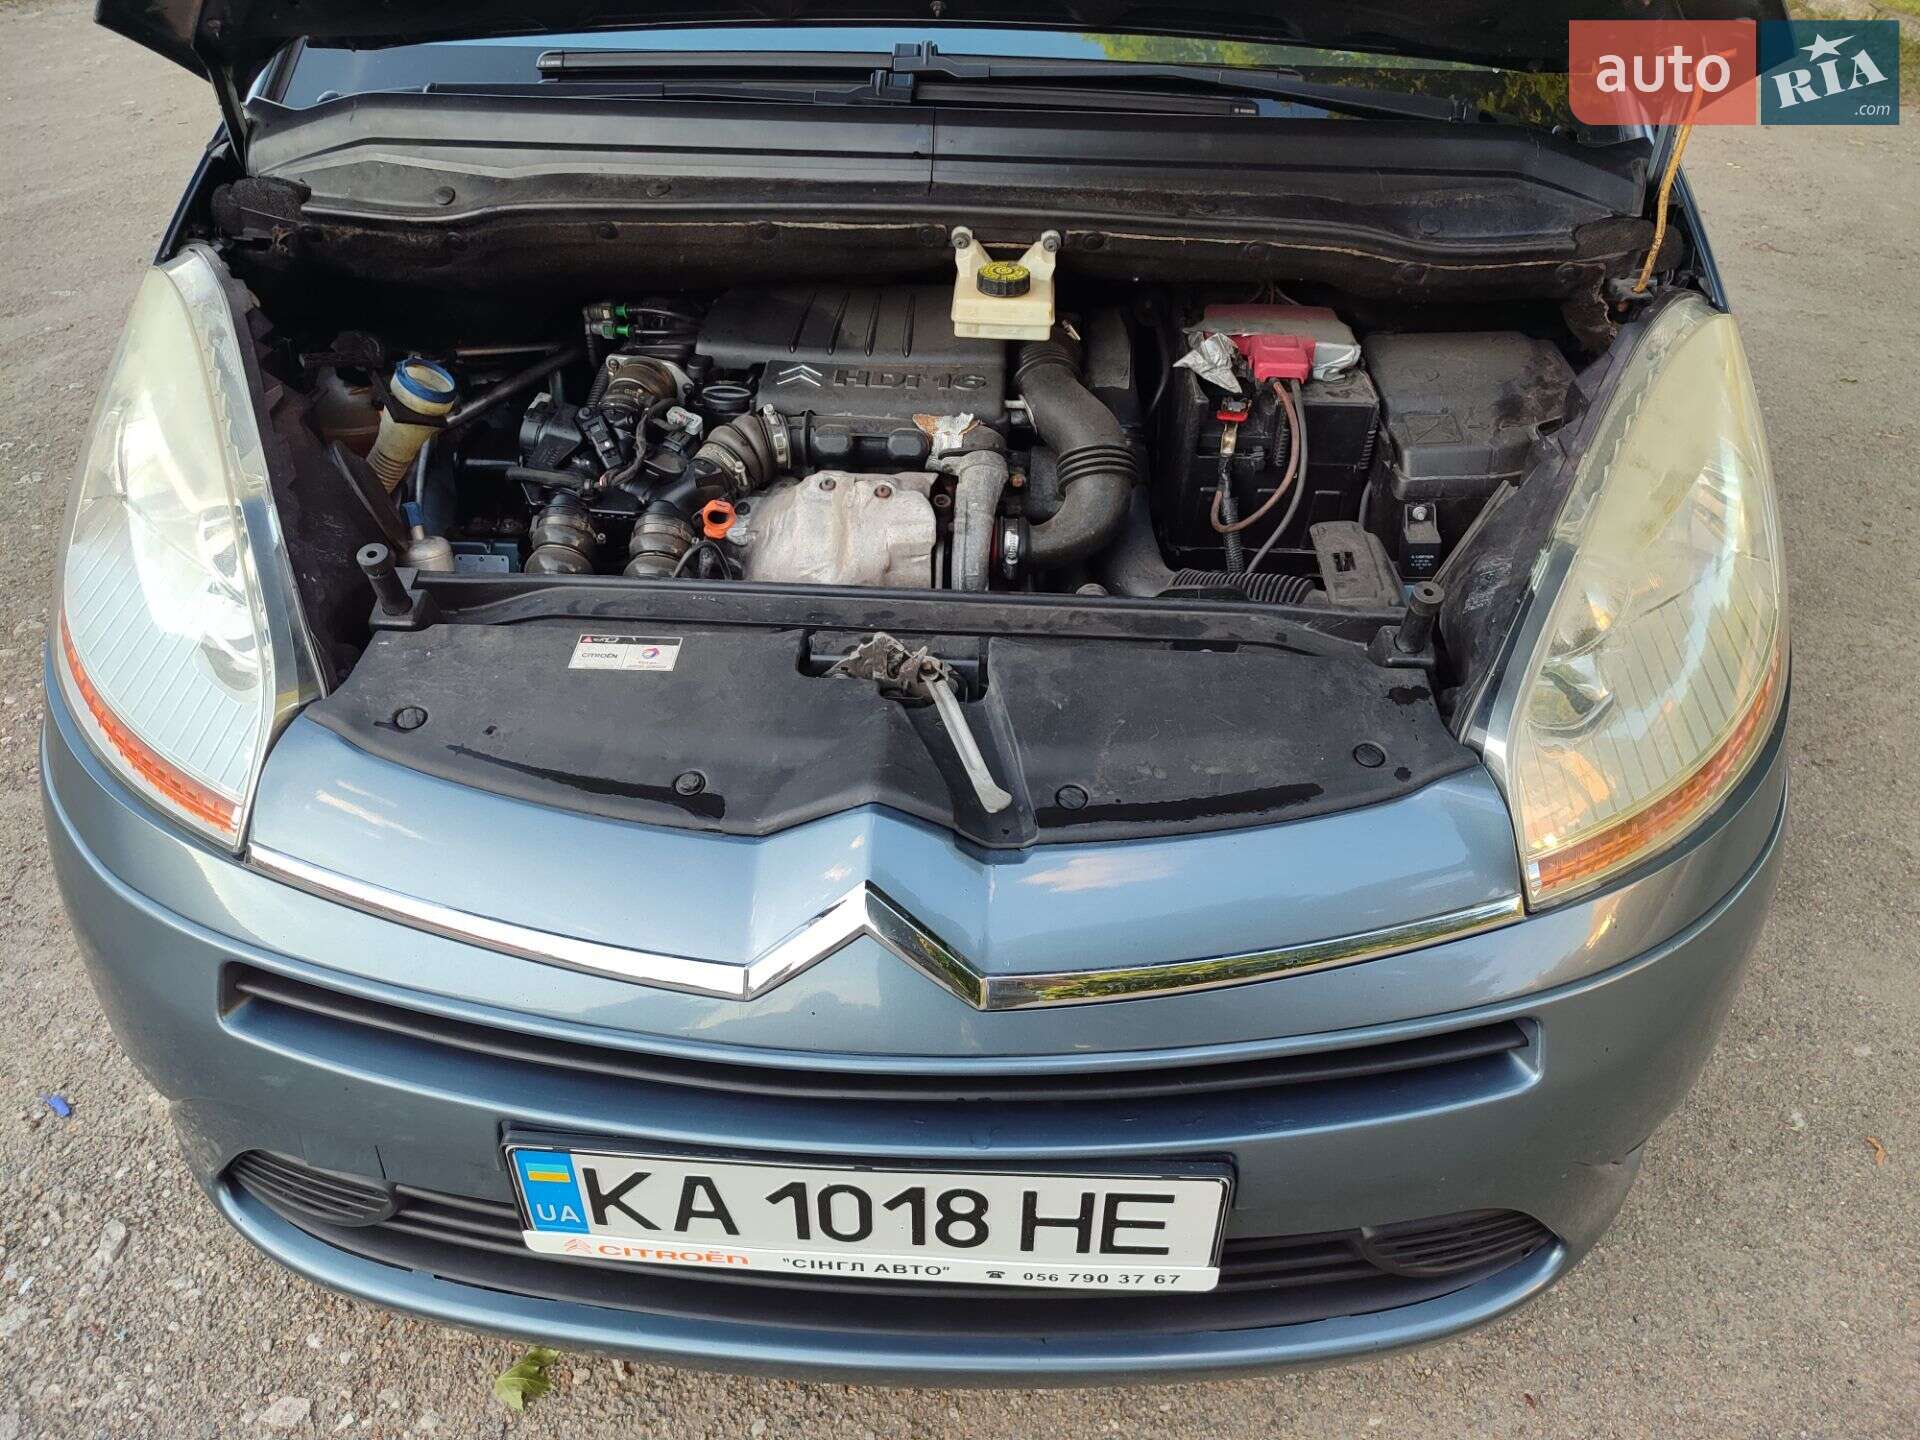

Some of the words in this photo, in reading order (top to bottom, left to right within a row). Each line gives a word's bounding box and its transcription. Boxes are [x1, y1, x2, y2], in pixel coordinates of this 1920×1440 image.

[536, 1203, 581, 1223] UA
[582, 1166, 741, 1236] KA
[764, 1180, 990, 1249] 1018
[1020, 1190, 1176, 1256] HE
[1023, 1272, 1059, 1282] 056
[1068, 1273, 1109, 1284] 790
[1118, 1274, 1146, 1284] 37
[1154, 1275, 1181, 1284] 67
